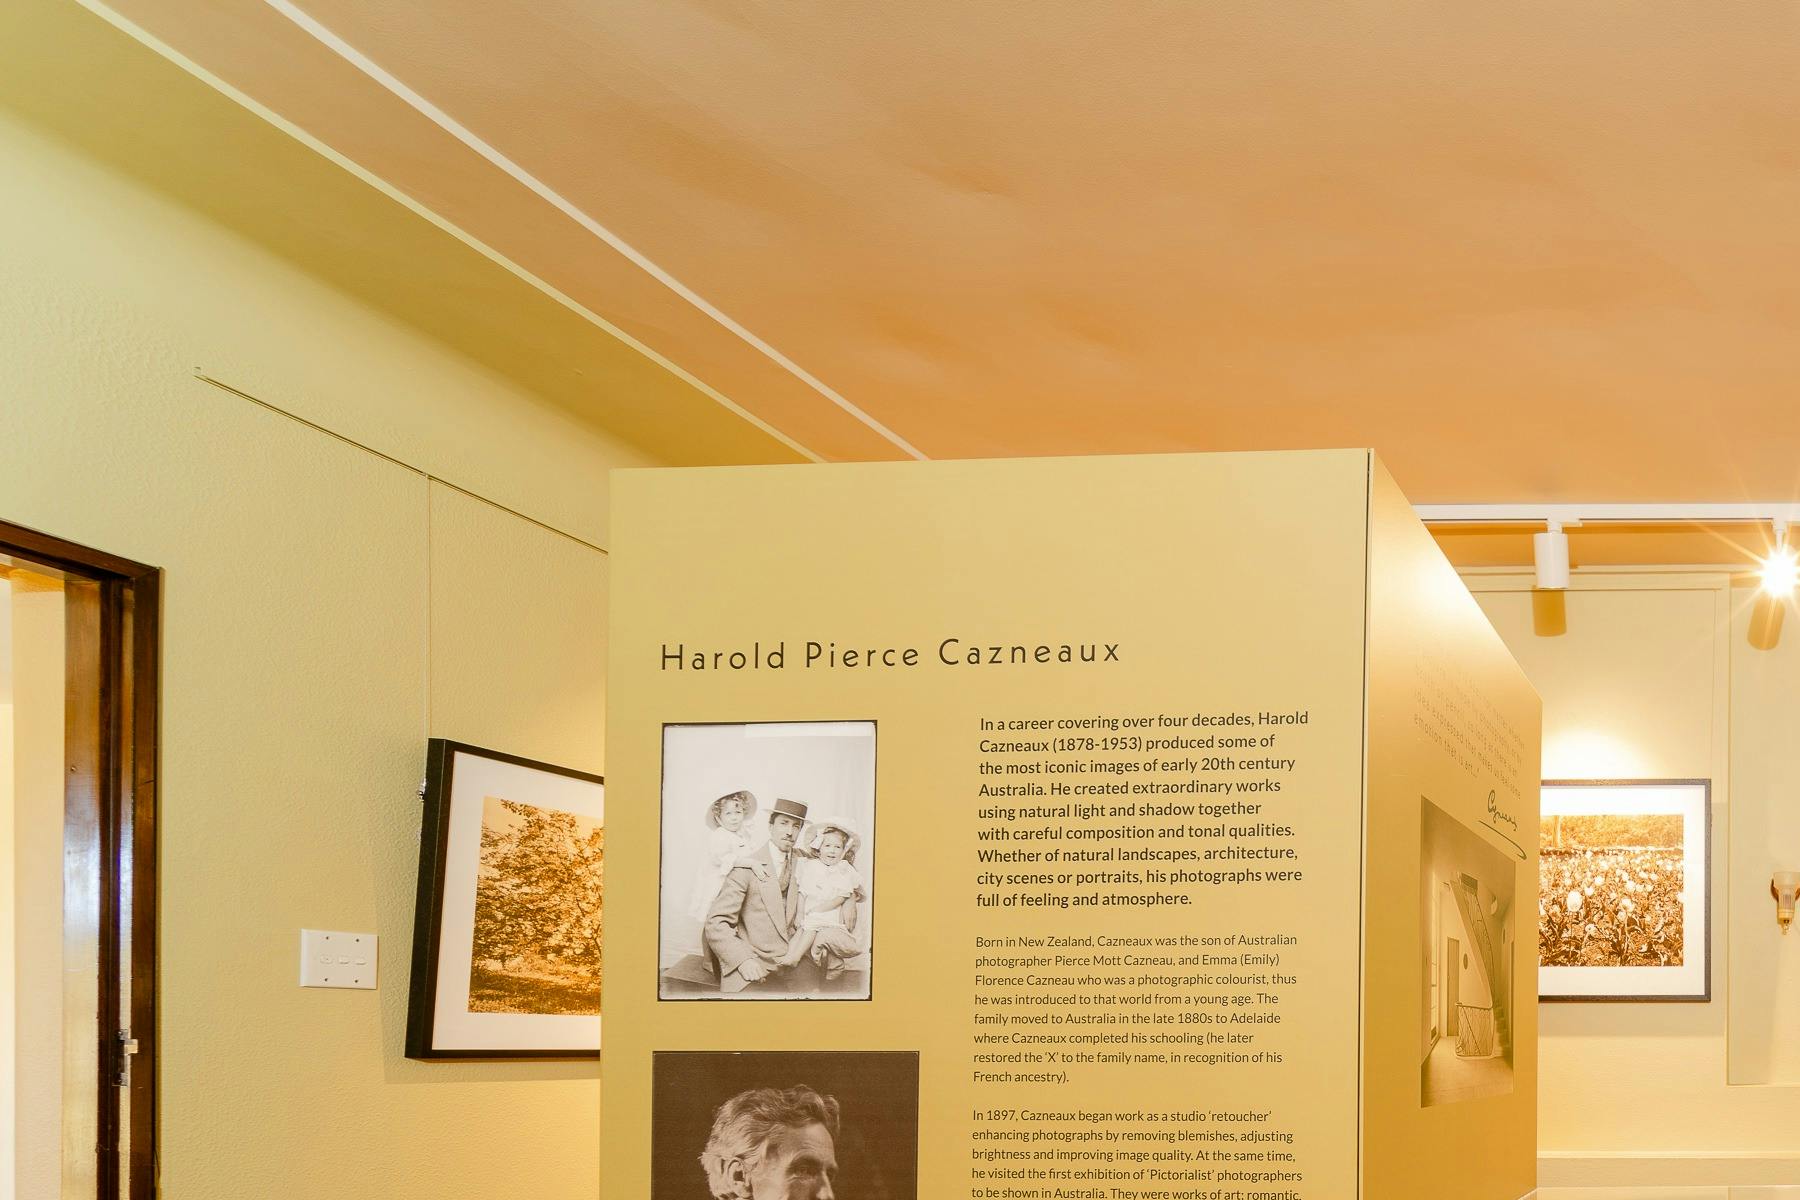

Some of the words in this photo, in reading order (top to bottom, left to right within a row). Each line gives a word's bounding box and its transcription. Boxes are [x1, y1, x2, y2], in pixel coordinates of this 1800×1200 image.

[661, 641, 784, 670] Harold
[806, 641, 919, 668] Pierce
[939, 638, 1119, 665] Cazneaux
[981, 718, 994, 731] In
[997, 721, 1005, 731] a
[1008, 720, 1055, 731] career
[1057, 715, 1119, 732] covering
[1122, 717, 1155, 728] over
[1157, 714, 1189, 727] four
[1191, 712, 1255, 728] decades,
[1258, 711, 1308, 725] Harold
[979, 739, 1050, 753] Cazneaux
[1052, 736, 1142, 755] (1878-1953)
[1146, 734, 1214, 753] produced
[1217, 737, 1257, 749] some
[1260, 733, 1275, 748] of
[979, 759, 1003, 775] the
[1006, 760, 1042, 775] most
[1044, 759, 1087, 774] iconic
[1090, 759, 1141, 776] images
[1143, 758, 1159, 772] of
[1161, 757, 1198, 774] early
[1201, 756, 1235, 771] 20th
[1238, 757, 1296, 772] century
[978, 782, 1047, 797] Australia.
[1050, 782, 1071, 796] He
[1074, 780, 1129, 797] created
[1132, 779, 1233, 799] extraordinary
[1235, 778, 1281, 793] works
[978, 805, 1016, 821] using
[1019, 803, 1070, 821] natural
[1074, 801, 1106, 820] light
[1109, 802, 1136, 817] and
[1138, 802, 1196, 817] shadow
[1198, 801, 1262, 818] together
[977, 826, 1010, 841] with
[1012, 826, 1062, 841] careful
[1065, 825, 1155, 842] composition
[1157, 824, 1185, 839] and
[1187, 823, 1225, 838] tonal
[1228, 823, 1295, 840] qualities.
[977, 849, 1042, 863] Whether
[1044, 848, 1060, 862] of
[1063, 847, 1114, 863] natural
[1118, 847, 1200, 863] landscapes,
[1203, 845, 1298, 863] architecture,
[977, 871, 1004, 888] city
[1005, 874, 1054, 886] scenes
[1057, 874, 1073, 884] or
[1076, 869, 1143, 887] portraits,
[1146, 869, 1167, 883] his
[1170, 867, 1262, 886] photographs
[1265, 871, 1302, 882] were
[976, 893, 999, 907] full
[1002, 893, 1018, 907] of
[1020, 892, 1069, 909] feeling
[1072, 892, 1099, 906] and
[1102, 891, 1192, 908] atmosphere.
[976, 936, 1003, 948] Born
[1005, 936, 1016, 948] in
[1018, 936, 1045, 949] New
[1046, 935, 1095, 949] Zealand,
[1097, 935, 1153, 947] Cazneaux
[1154, 938, 1177, 947] was
[1180, 935, 1199, 946] the
[1201, 937, 1221, 946] son
[1223, 934, 1236, 946] of
[1237, 934, 1297, 946] Australian
[975, 955, 1053, 969] photographer
[1055, 955, 1091, 967] Pierce
[1093, 955, 1122, 966] Mott
[1123, 954, 1176, 966] Cazneau,
[1178, 954, 1199, 966] and
[1202, 954, 1237, 966] Emma
[1240, 953, 1279, 967] (Emily)
[974, 1071, 1012, 1082] French
[1015, 1071, 1069, 1084] ancestry).
[973, 1110, 984, 1121] In
[987, 1109, 1018, 1122] 1897,
[1020, 1110, 1076, 1121] Cazneaux
[1078, 1110, 1113, 1124] began
[1114, 1110, 1144, 1122] work
[1146, 1113, 1159, 1122] as
[1161, 1113, 1168, 1122] a
[1170, 1110, 1206, 1122] studio
[1208, 1110, 1272, 1122] ‘retoucher’
